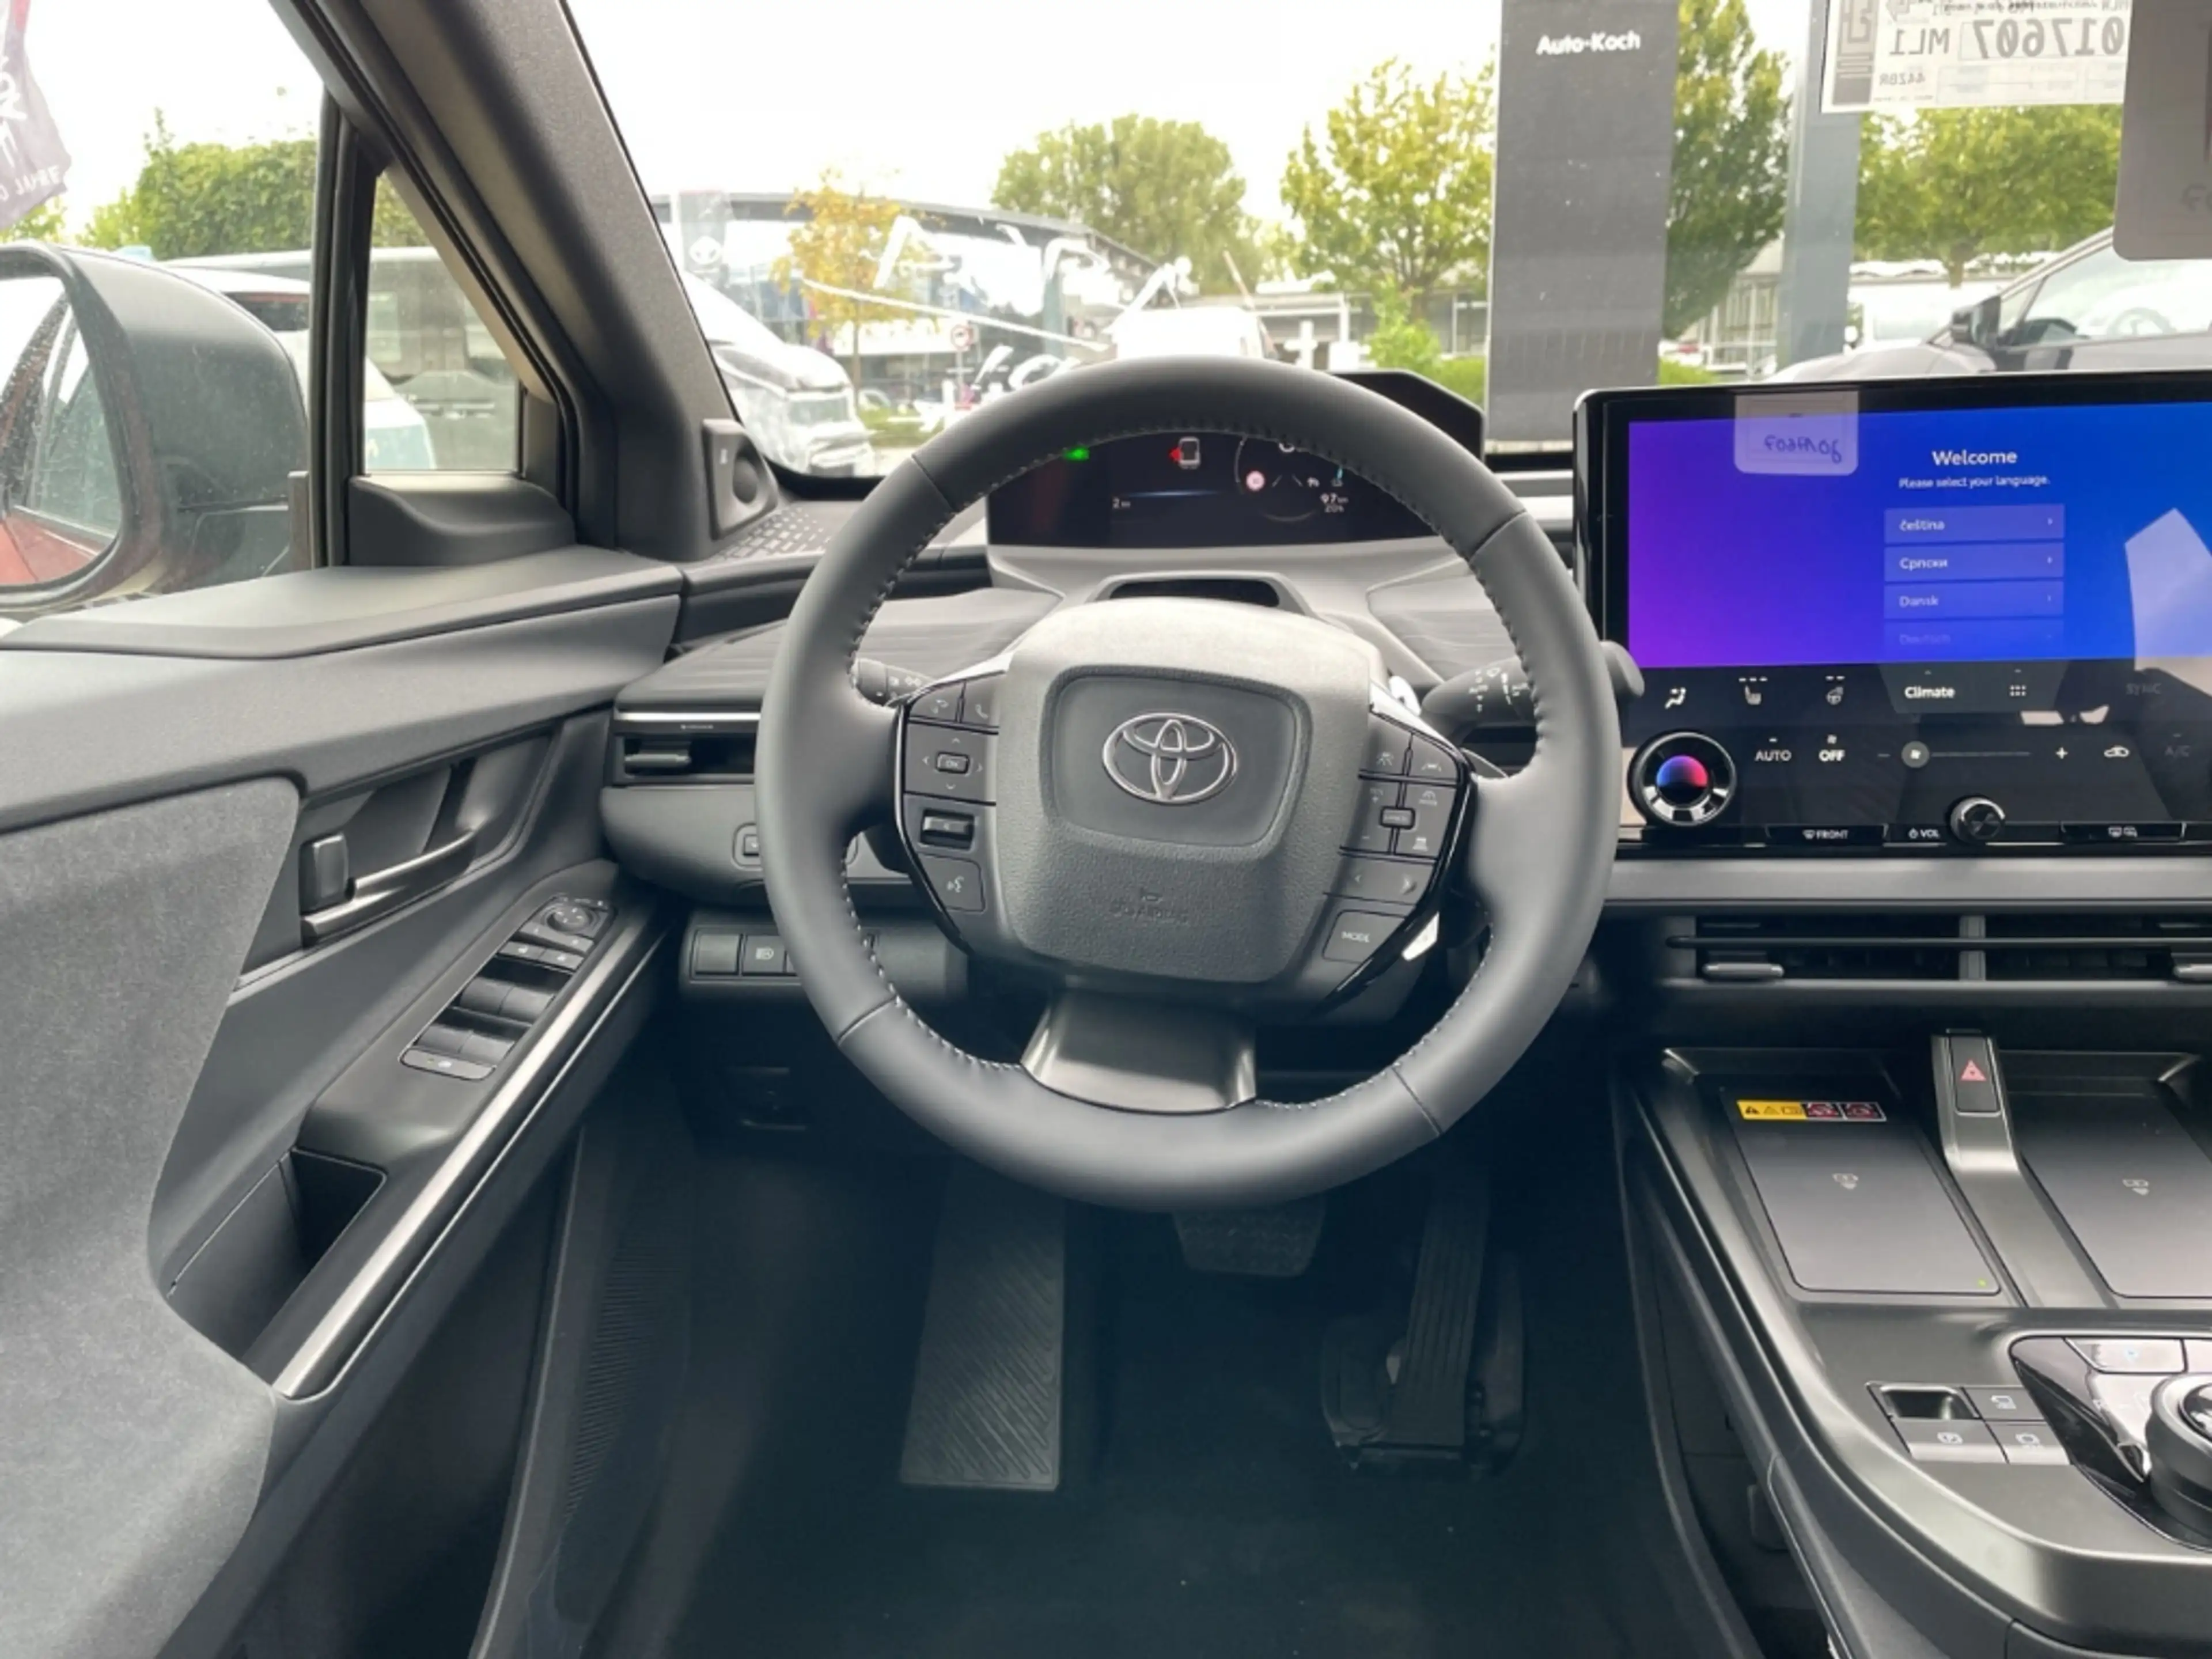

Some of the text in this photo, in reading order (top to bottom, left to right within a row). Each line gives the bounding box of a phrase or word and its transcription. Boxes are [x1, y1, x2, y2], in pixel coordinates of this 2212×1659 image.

[1535, 29, 1641, 56] Auto-Koch
[1931, 450, 2018, 466] Welcome
[1899, 475, 2051, 489] Please select your language.
[1899, 595, 1939, 608] Dansk
[1904, 685, 1957, 699] Climate
[1755, 750, 1846, 762] AUTO OFF
[1815, 829, 1849, 840] FRONT
[1921, 829, 1940, 838] VOL
[1341, 931, 1370, 943] MODE
